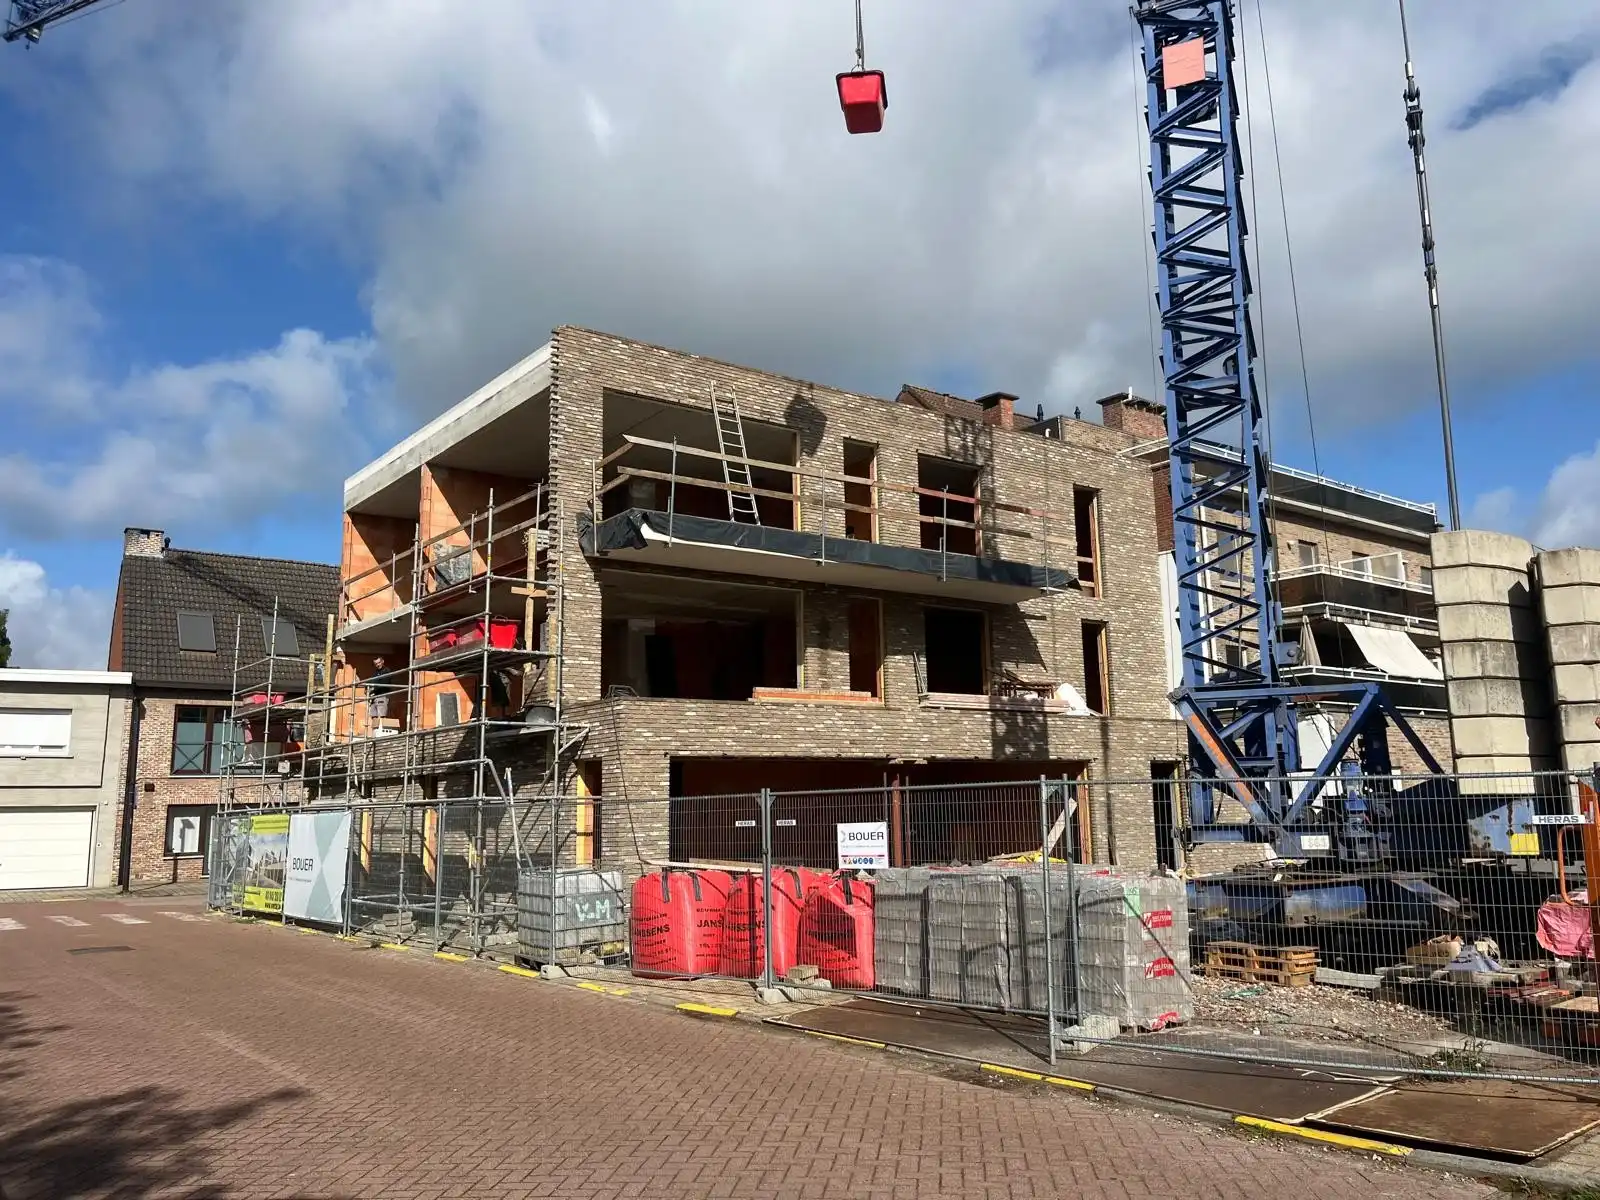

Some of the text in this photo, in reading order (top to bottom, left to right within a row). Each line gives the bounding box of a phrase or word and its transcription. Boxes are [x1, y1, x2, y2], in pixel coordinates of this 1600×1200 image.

[1538, 815, 1579, 824] HERAS
[848, 831, 884, 841] BOUER
[292, 857, 314, 871] BOUER
